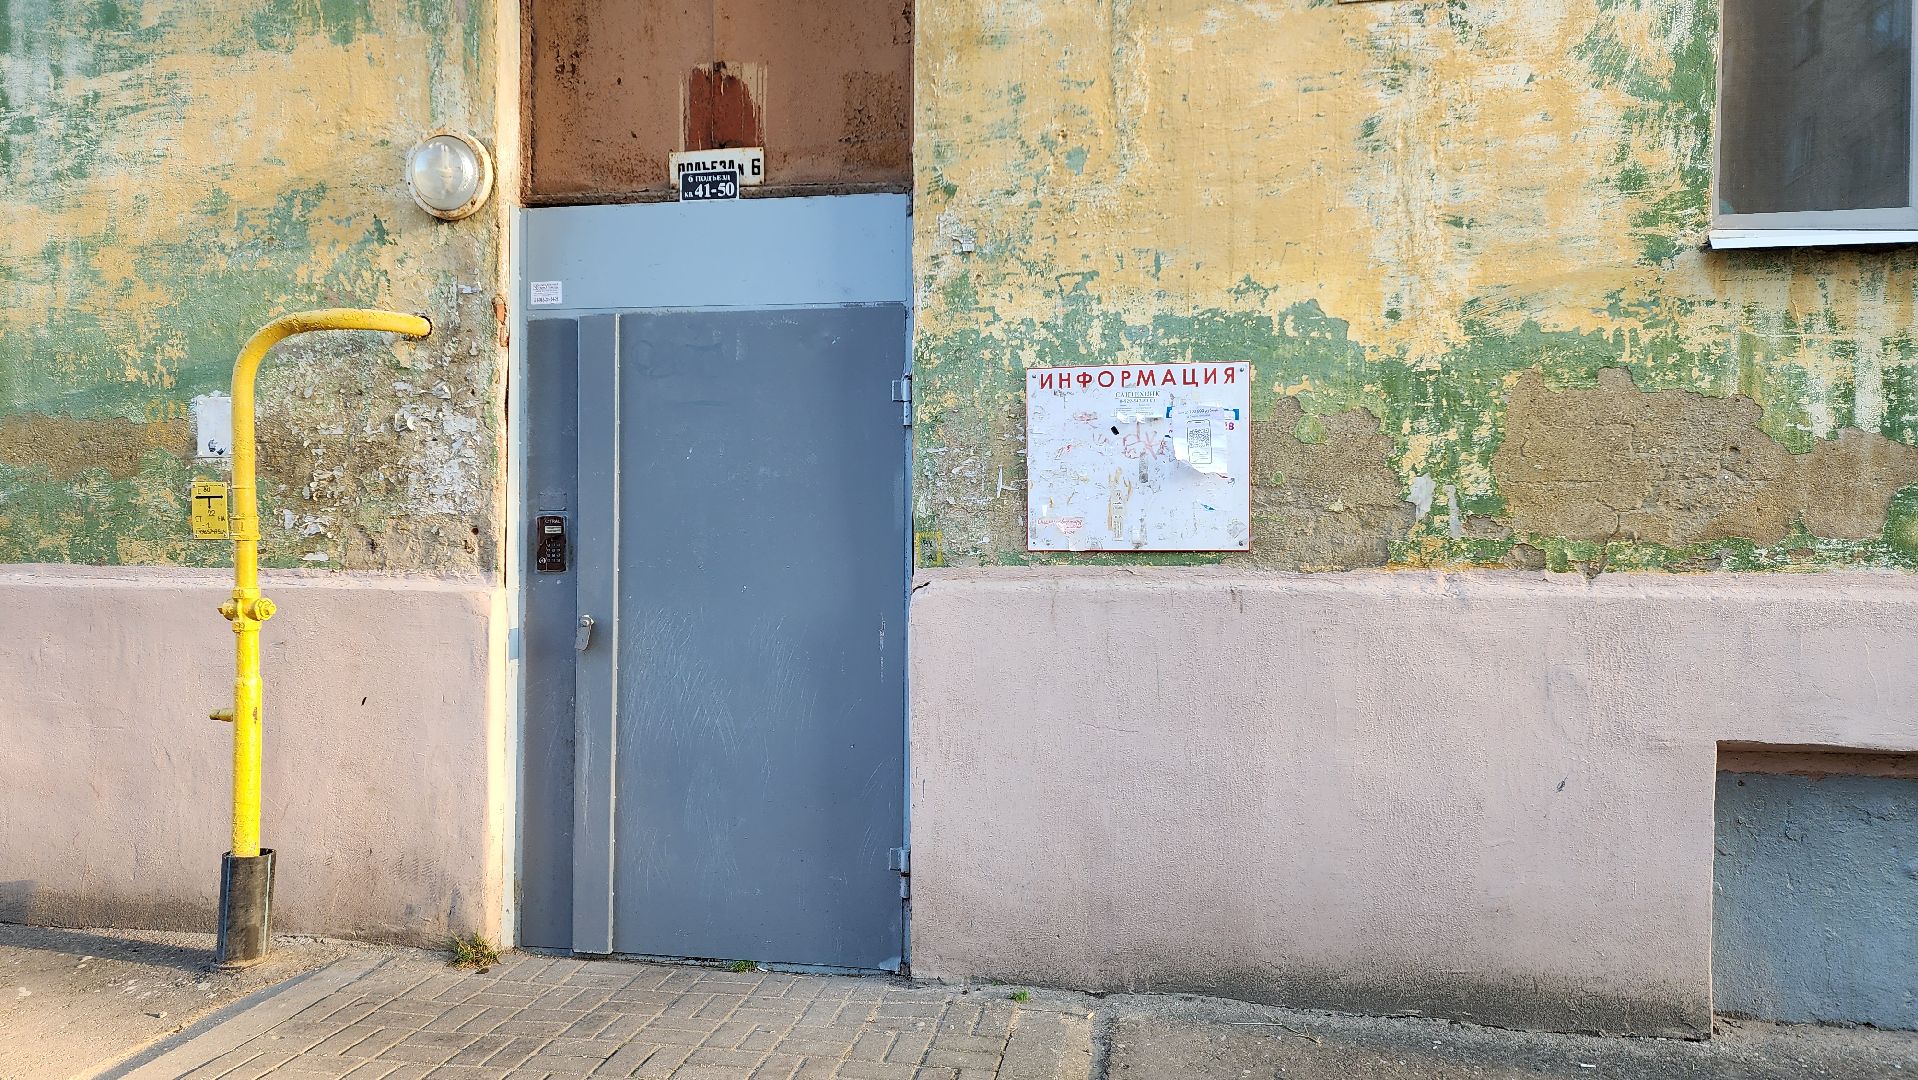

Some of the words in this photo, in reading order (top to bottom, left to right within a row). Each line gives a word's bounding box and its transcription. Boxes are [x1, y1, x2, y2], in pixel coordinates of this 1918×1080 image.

[751, 158, 761, 175] 6
[694, 182, 735, 198] 41-50
[1040, 366, 1235, 390] ИНФОРМАЦИЯ
